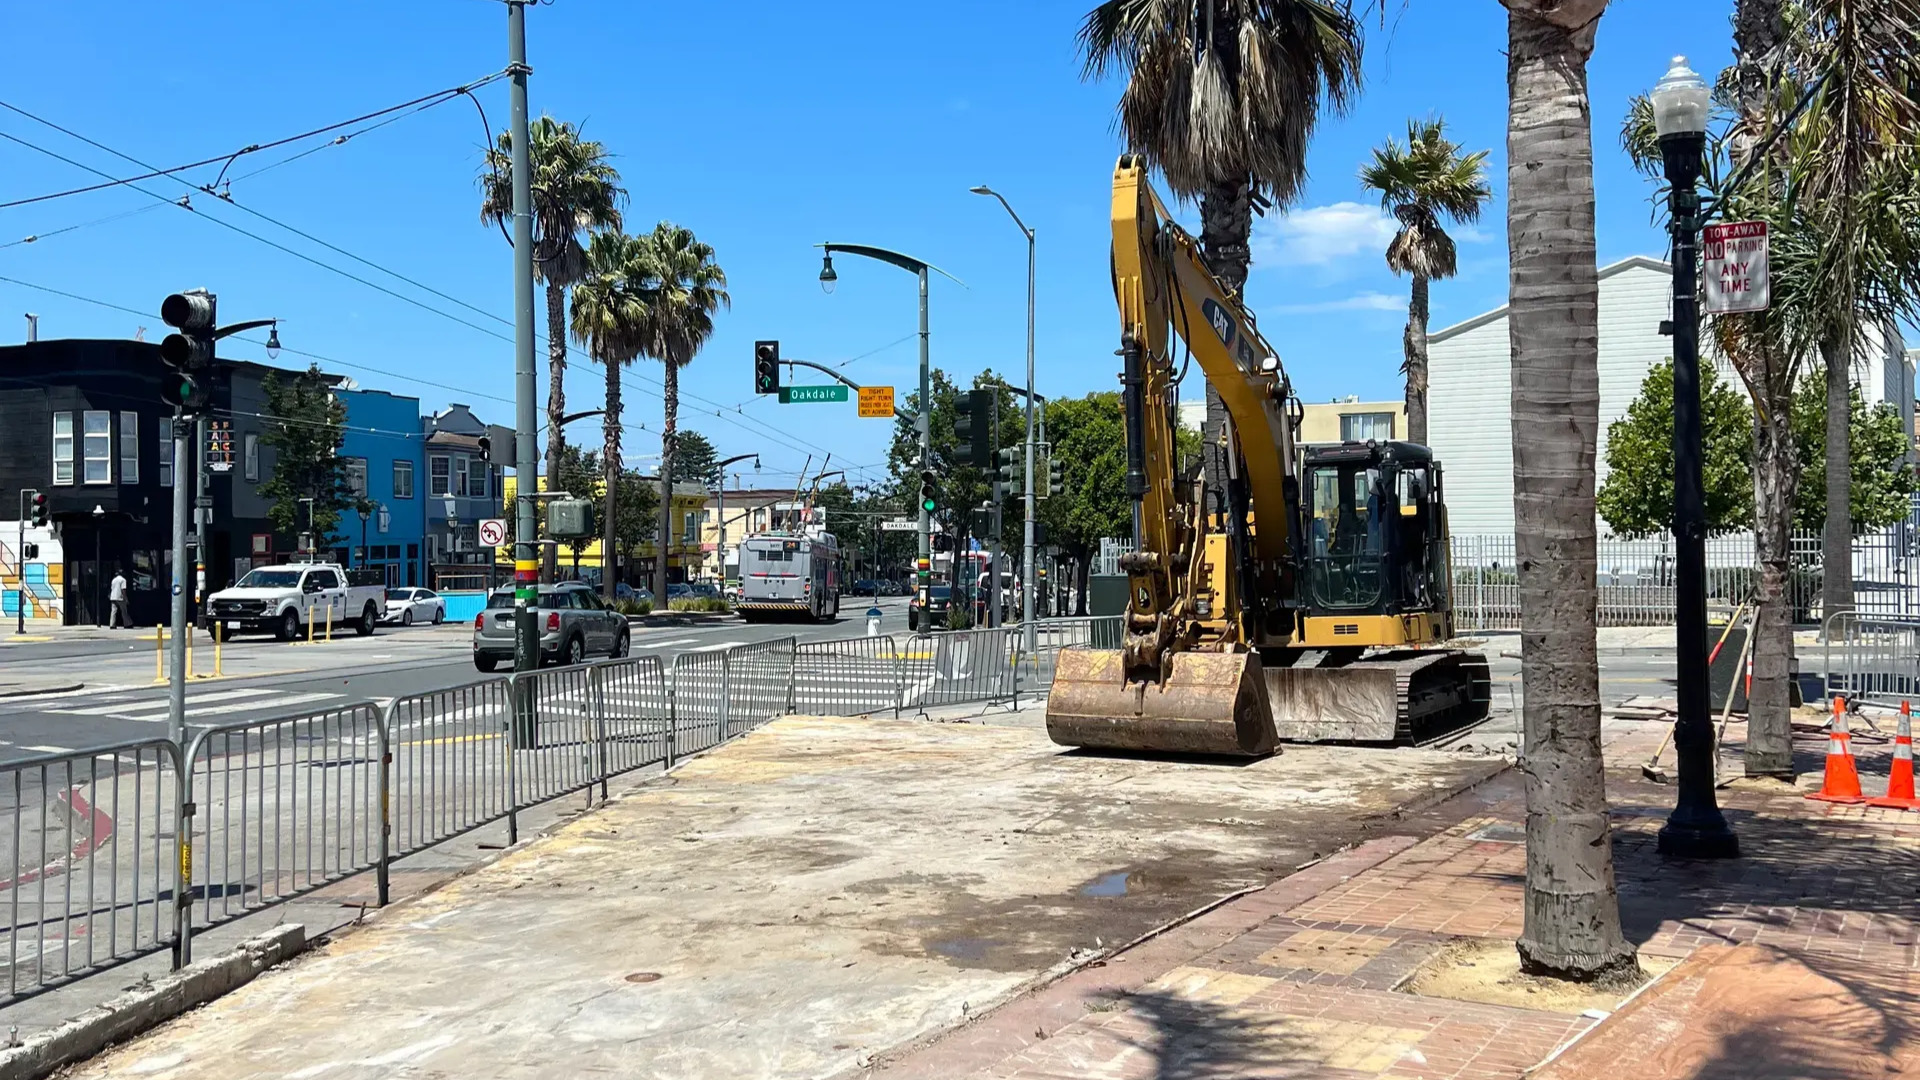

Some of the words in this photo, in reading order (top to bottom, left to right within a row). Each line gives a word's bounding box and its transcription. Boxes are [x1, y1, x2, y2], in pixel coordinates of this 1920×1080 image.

[1709, 223, 1762, 239] TOW-AWAY
[1705, 241, 1724, 260] NO
[1726, 239, 1763, 254] PARKING
[1721, 261, 1749, 277] ANY
[1719, 278, 1751, 294] TIME
[1213, 305, 1229, 342] CAT
[791, 389, 836, 400] Oakdale
[786, 541, 796, 549] 24
